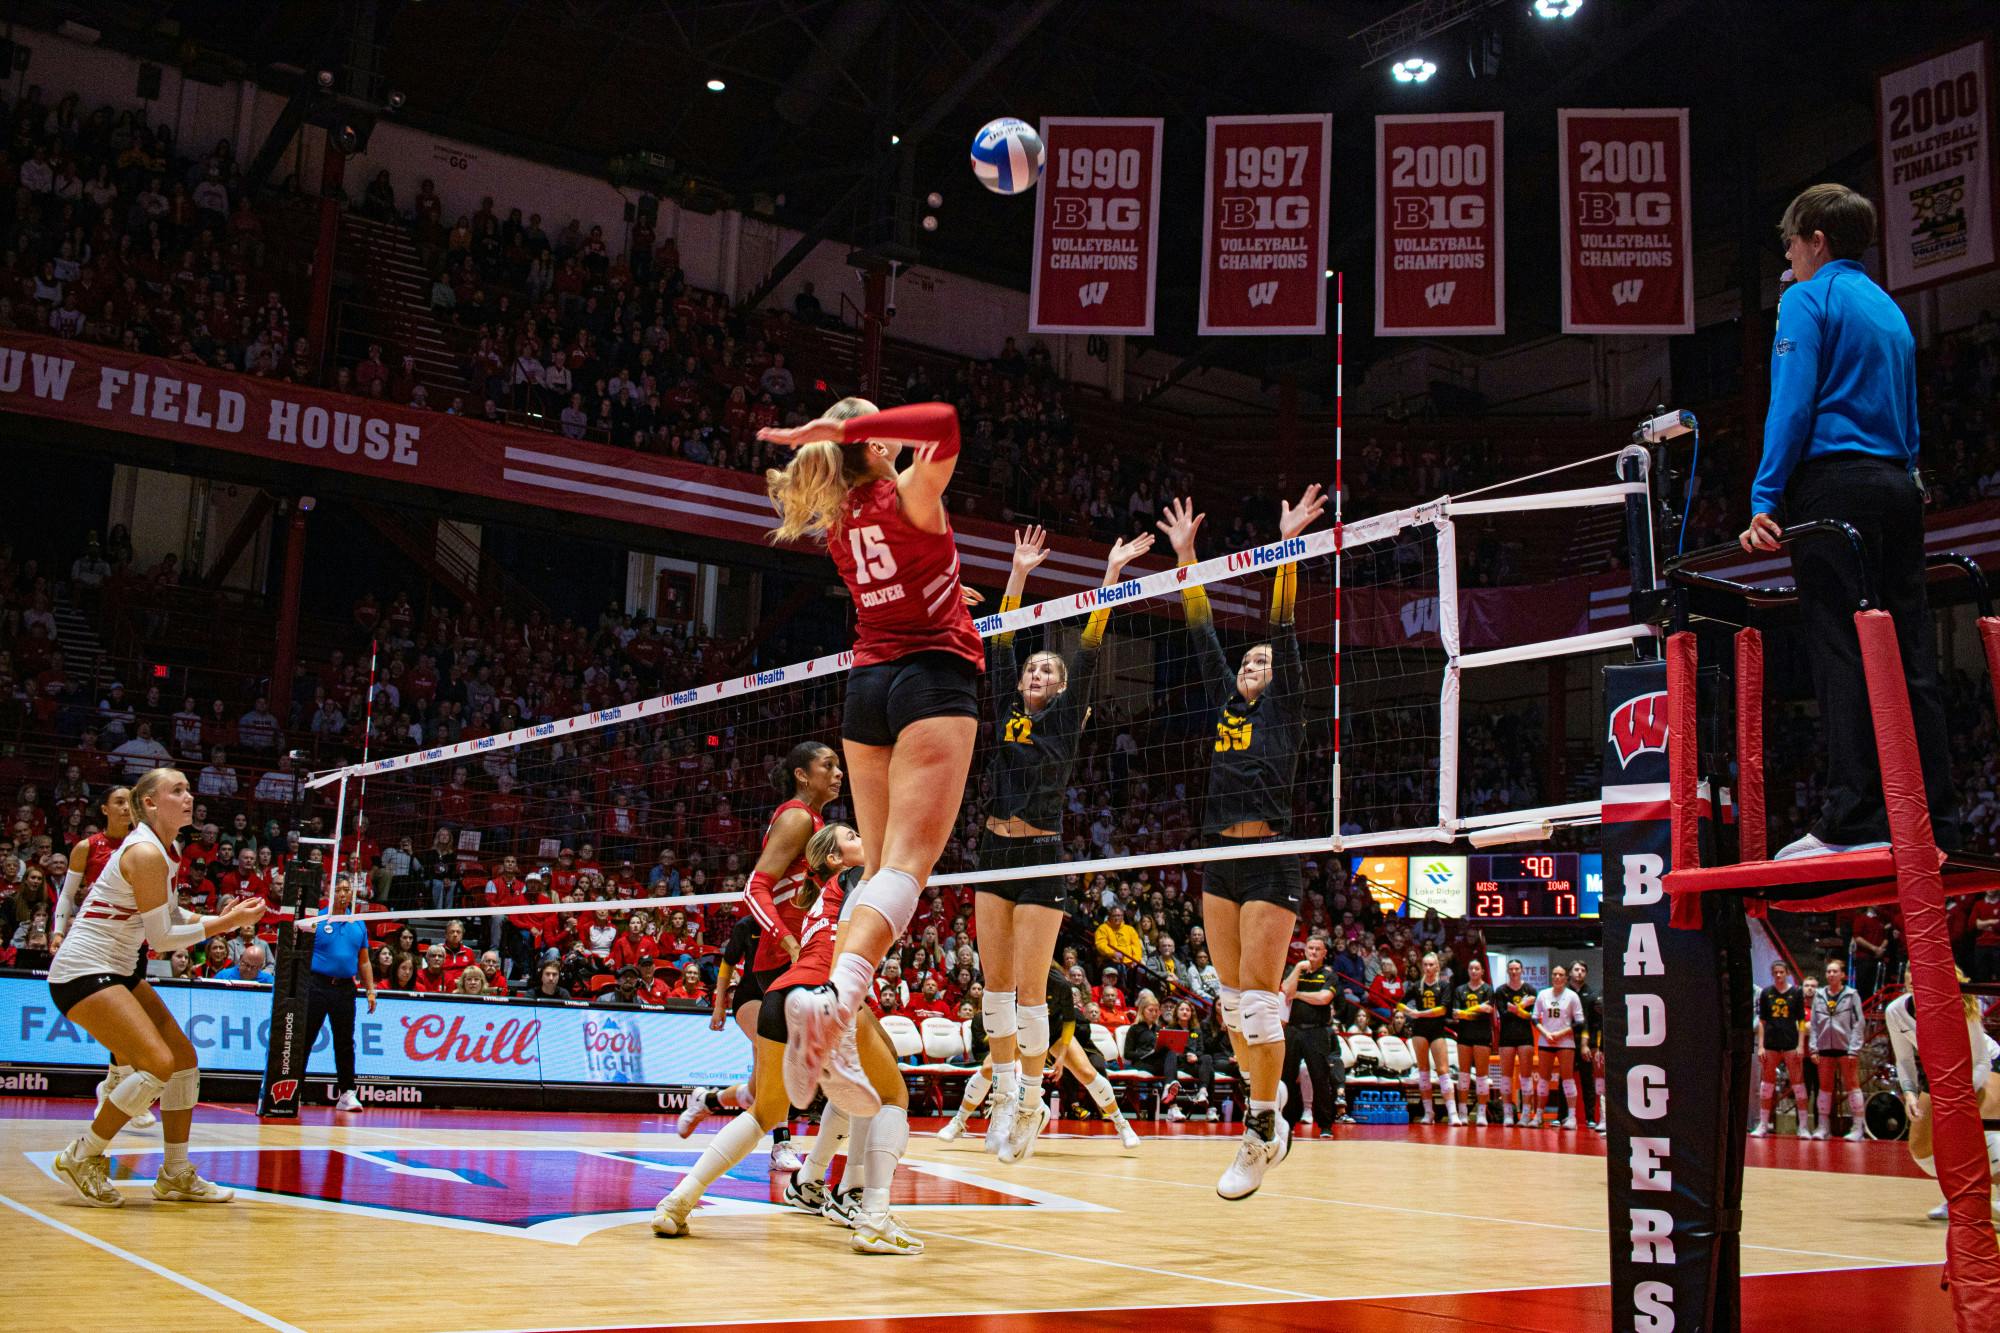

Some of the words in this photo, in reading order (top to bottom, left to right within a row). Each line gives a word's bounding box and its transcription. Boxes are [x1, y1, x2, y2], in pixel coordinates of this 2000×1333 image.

[1889, 71, 1978, 141] 2000
[1892, 123, 1978, 162] VOLLEYBALL
[1056, 148, 1141, 190] 1990
[1224, 146, 1310, 188] 1997
[1392, 144, 1487, 188] 2000
[1579, 140, 1667, 183] 2001
[1893, 140, 1978, 185] FINALIST
[1051, 237, 1139, 252] VOLLEYBALL
[1220, 237, 1309, 252] VOLLEYBALL
[1394, 236, 1485, 252] VOLLEYBALL
[1579, 233, 1673, 249] VOLLEYBALL
[1050, 254, 1139, 271] CHAMPIONS
[1219, 253, 1309, 270] CHAMPIONS
[1393, 253, 1485, 270] CHAMPIONS
[1579, 250, 1673, 267] CHAMPIONS
[0, 347, 76, 401] UW
[97, 365, 246, 434] FIELD
[267, 399, 421, 466] HOUSE
[848, 524, 898, 585] 15
[860, 583, 906, 608] COLYER
[974, 614, 1003, 633] ealth
[1003, 717, 1034, 745] 12
[1608, 690, 1669, 770] W
[1415, 887, 1435, 896] Lake
[1436, 887, 1461, 898] Ridge
[1476, 882, 1498, 892] WISC
[1547, 881, 1570, 891] IOWA
[1427, 897, 1448, 905] Bank
[1477, 895, 1504, 917] 23
[1523, 900, 1529, 915] 1
[1556, 894, 1576, 915] 17
[1424, 997, 1437, 1009] 15
[1547, 1007, 1561, 1019] 16
[1771, 1005, 1790, 1019] 24
[285, 1013, 294, 1040] sports
[582, 1021, 643, 1054] Coors
[282, 1041, 292, 1075] imports
[588, 1052, 644, 1074] LIGHT
[0, 1072, 49, 1091] ealth
[1621, 853, 1677, 1333] BADGERS
